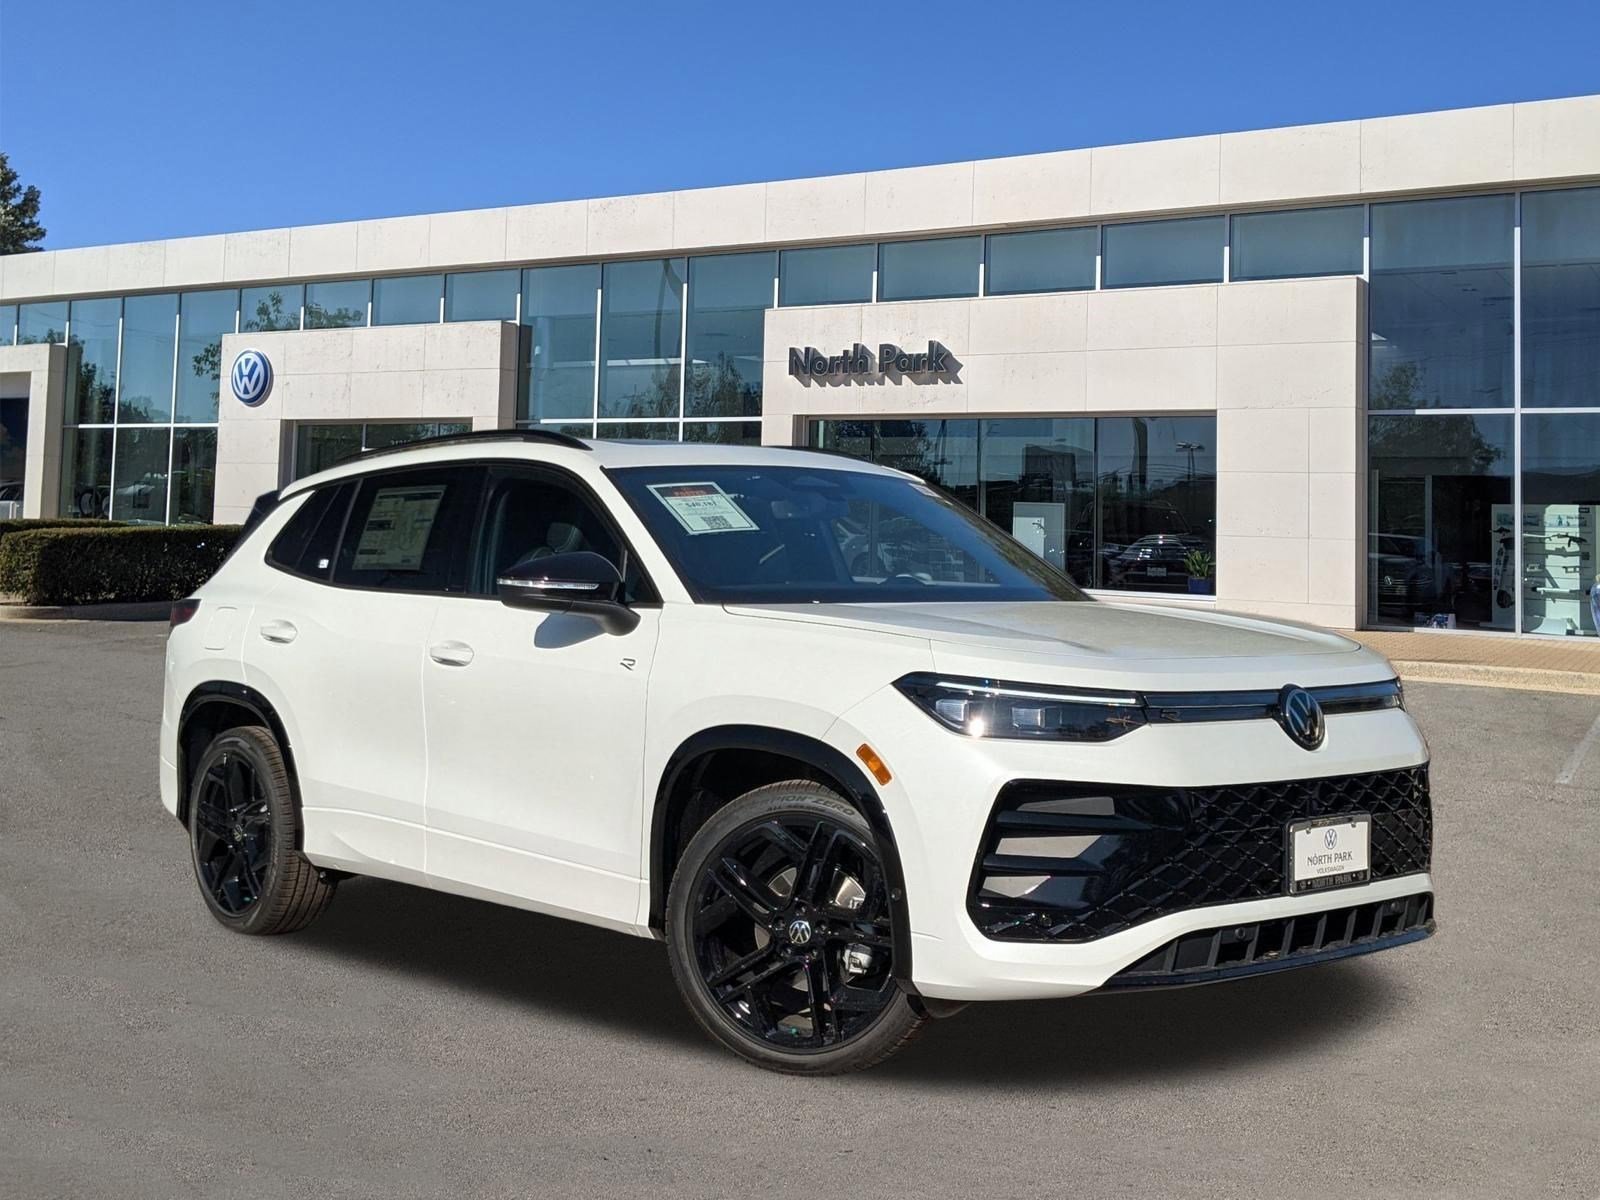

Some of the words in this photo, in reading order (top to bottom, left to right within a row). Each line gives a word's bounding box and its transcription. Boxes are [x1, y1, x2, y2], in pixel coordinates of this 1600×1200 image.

[789, 343, 873, 376] North
[879, 340, 948, 374] Park
[1307, 852, 1333, 866] NORTH
[1334, 851, 1353, 863] PARK
[1316, 865, 1345, 874] VOLKSWAGEN
